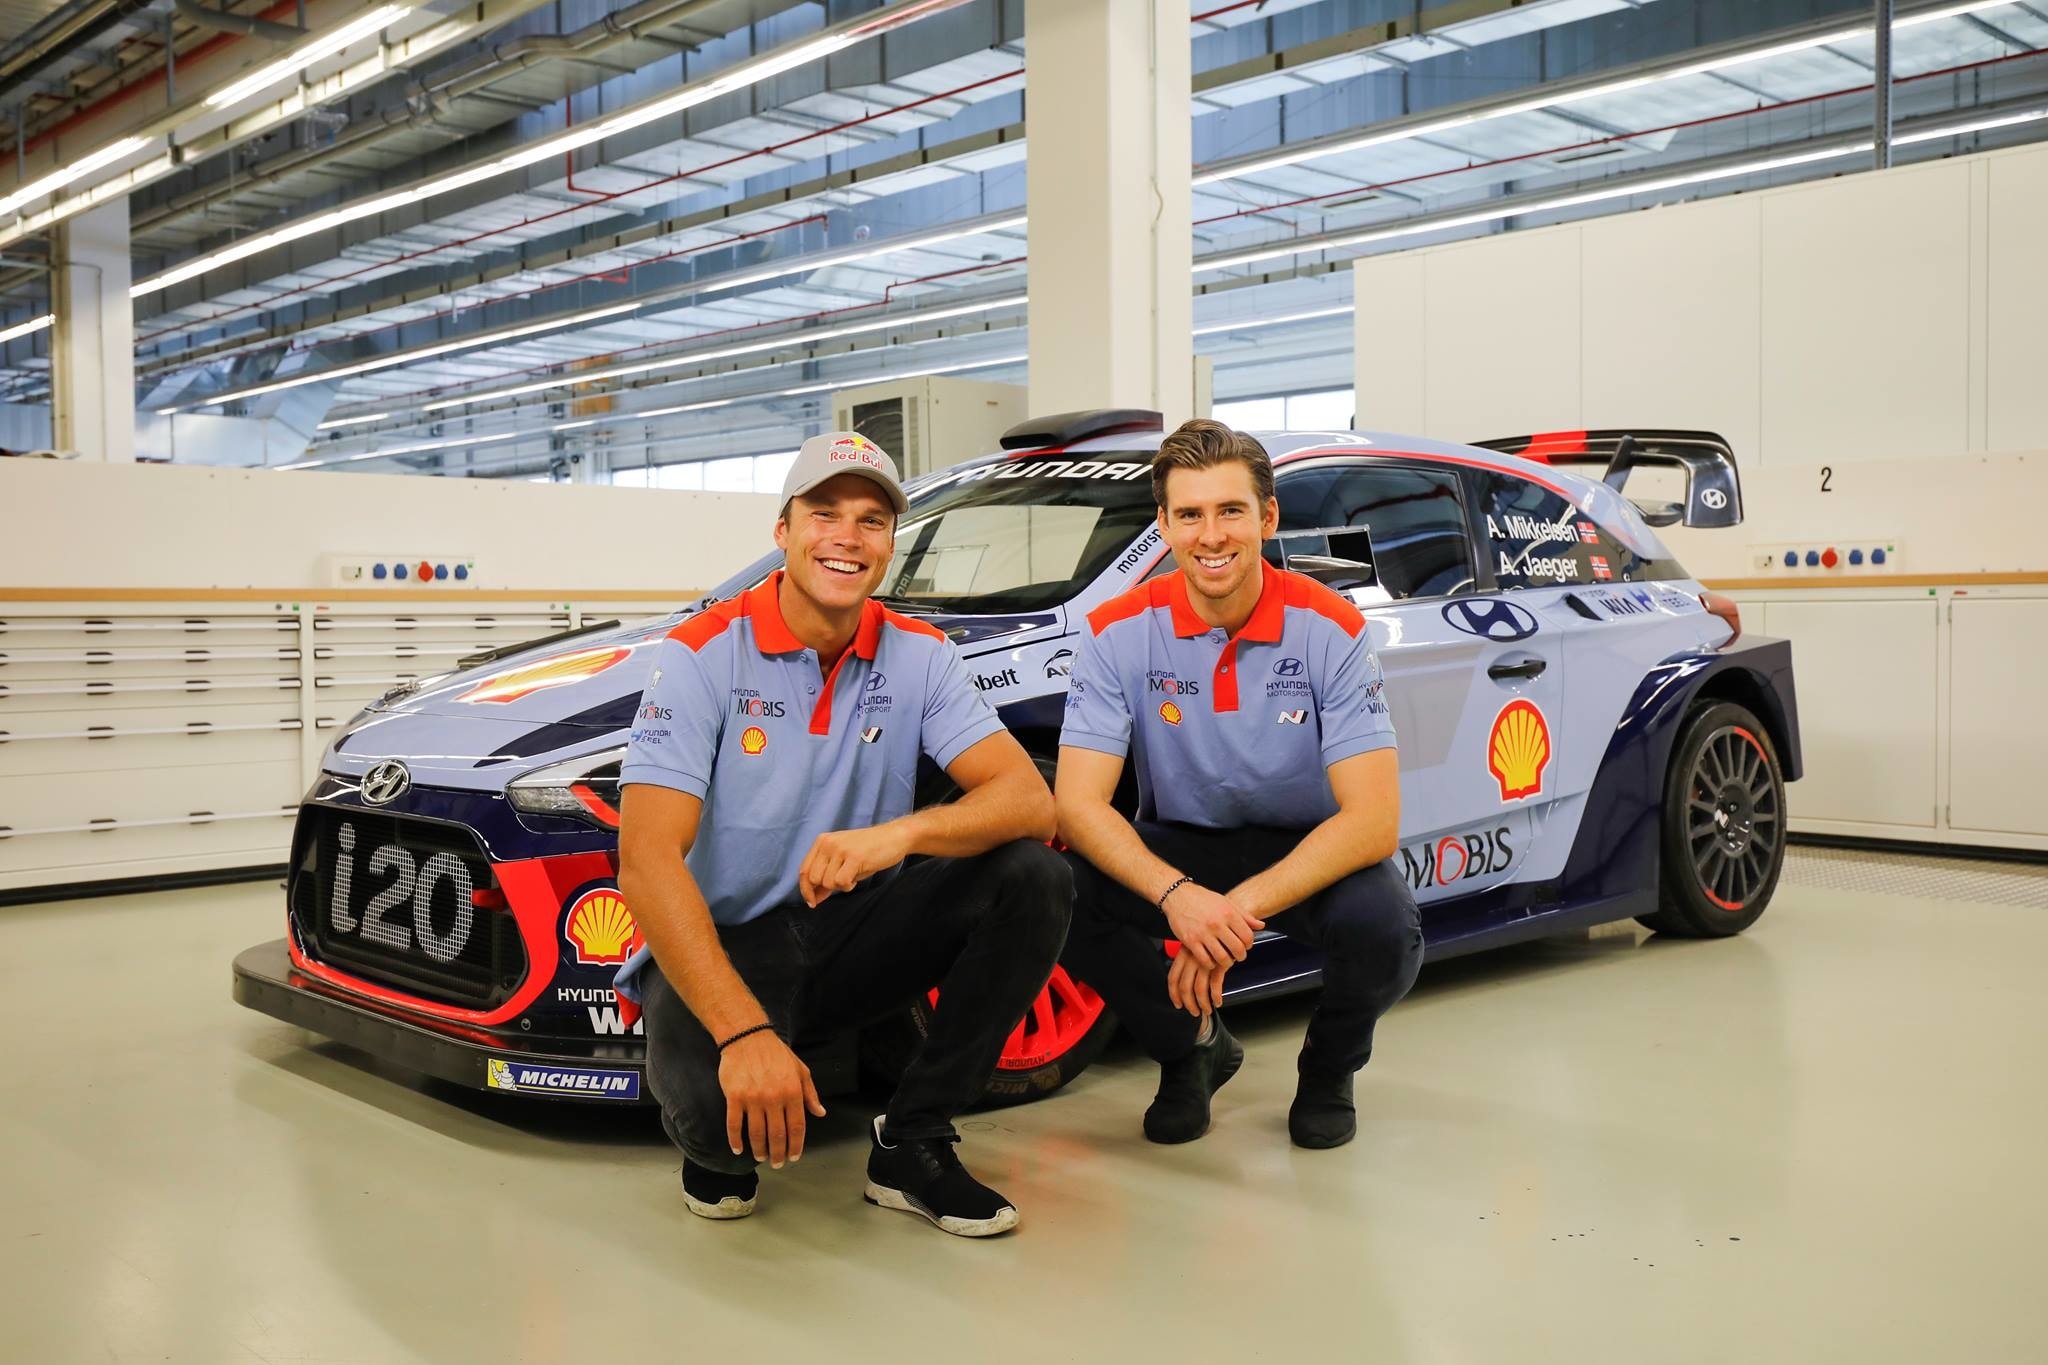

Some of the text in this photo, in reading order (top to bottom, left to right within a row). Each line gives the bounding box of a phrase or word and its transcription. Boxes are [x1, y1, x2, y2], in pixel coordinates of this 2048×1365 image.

[829, 450, 884, 471] Red Bull
[1821, 466, 1832, 492] 2
[1486, 514, 1580, 543] A. Mikkelsen
[1499, 551, 1579, 583] A. Jaeger
[974, 668, 1020, 691] belt
[1150, 678, 1200, 695] MOBIS
[736, 698, 786, 718] MOBIS
[1400, 826, 1513, 890] MOBIS
[331, 822, 474, 962] i20
[558, 988, 618, 1003] HYUND
[519, 1070, 630, 1091] MICHELIN
